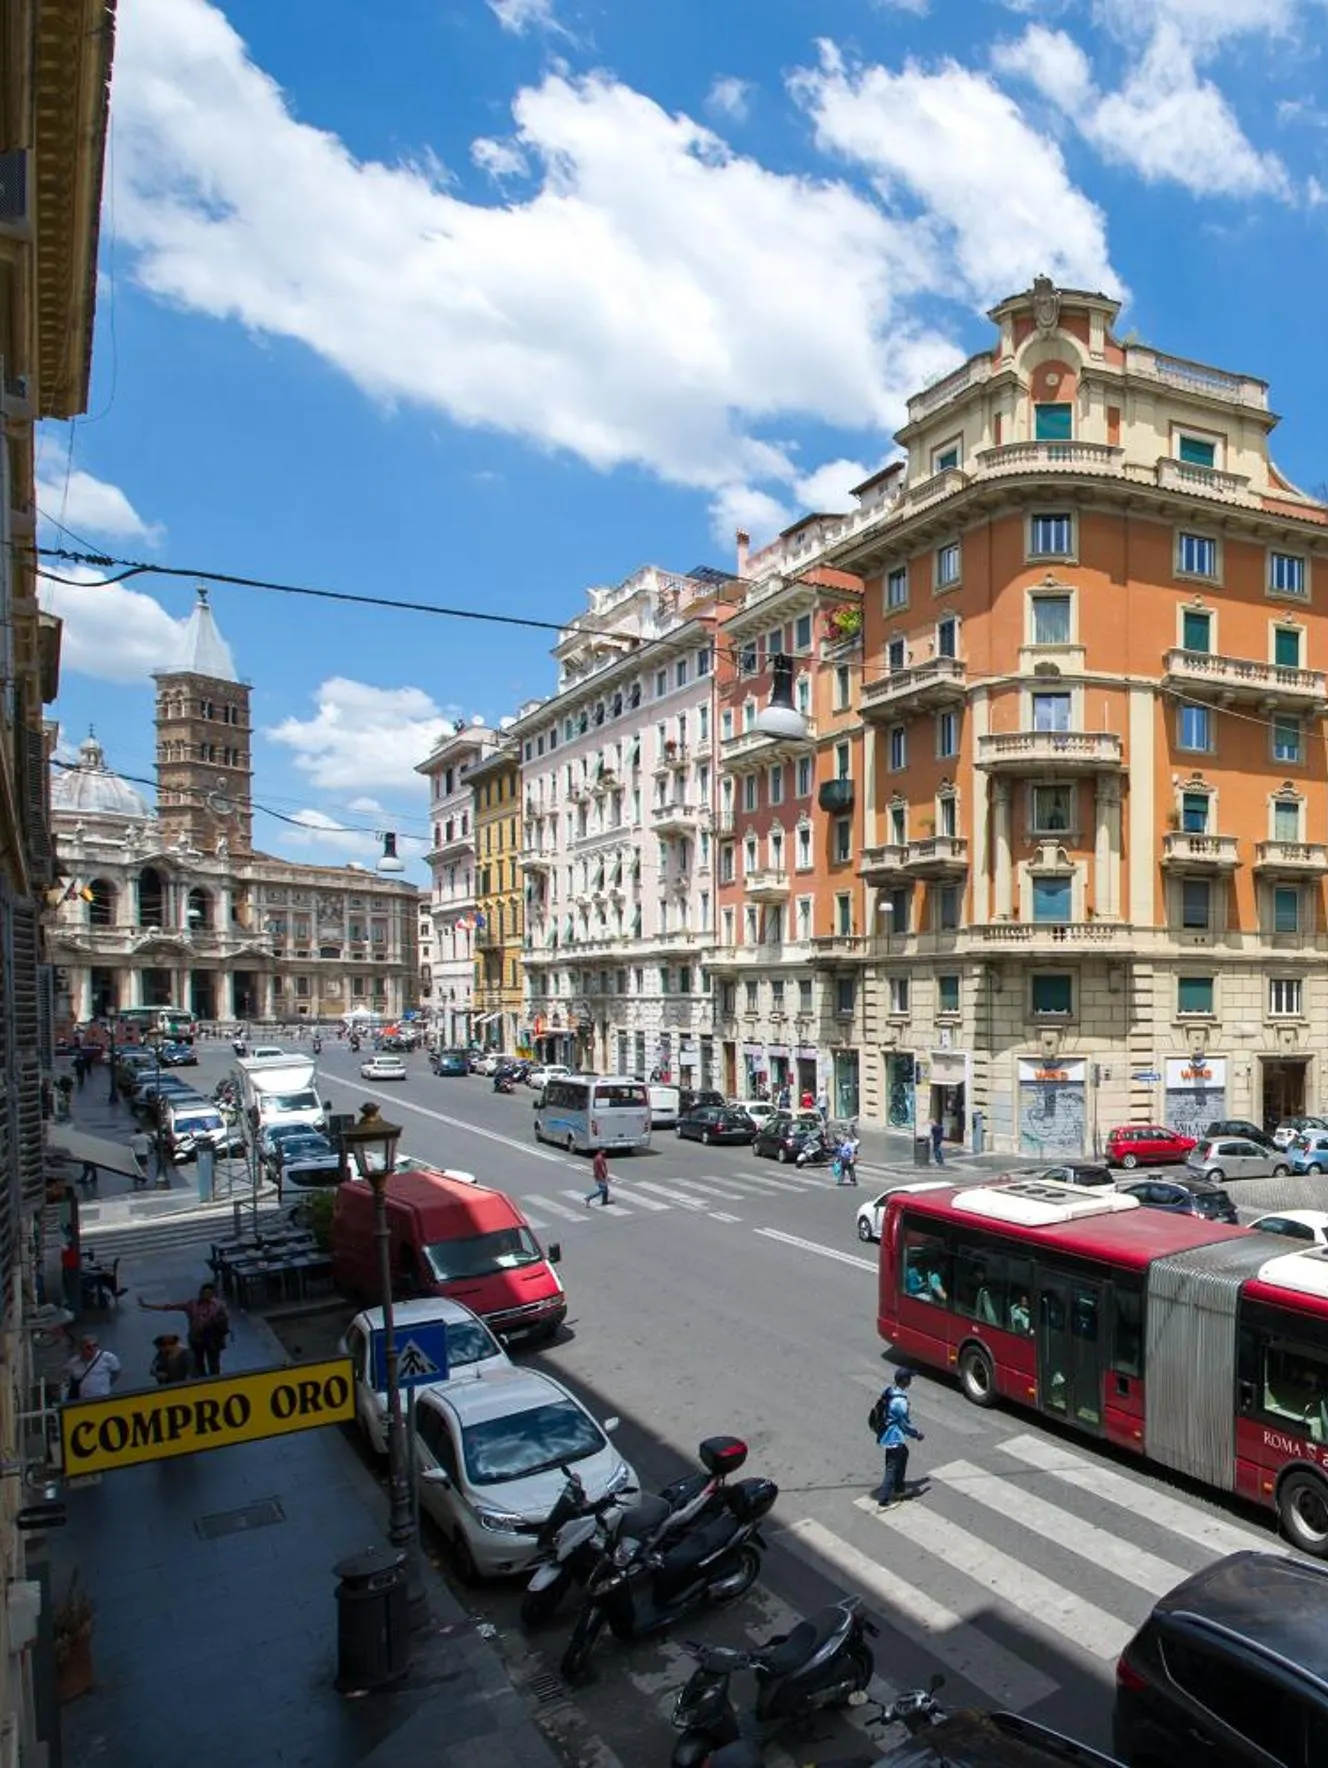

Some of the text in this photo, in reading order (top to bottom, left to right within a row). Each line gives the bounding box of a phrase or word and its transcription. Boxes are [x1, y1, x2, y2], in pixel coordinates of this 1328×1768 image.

[70, 1375, 349, 1458] COMPRO ORO
[1263, 1430, 1301, 1457] ROMA
